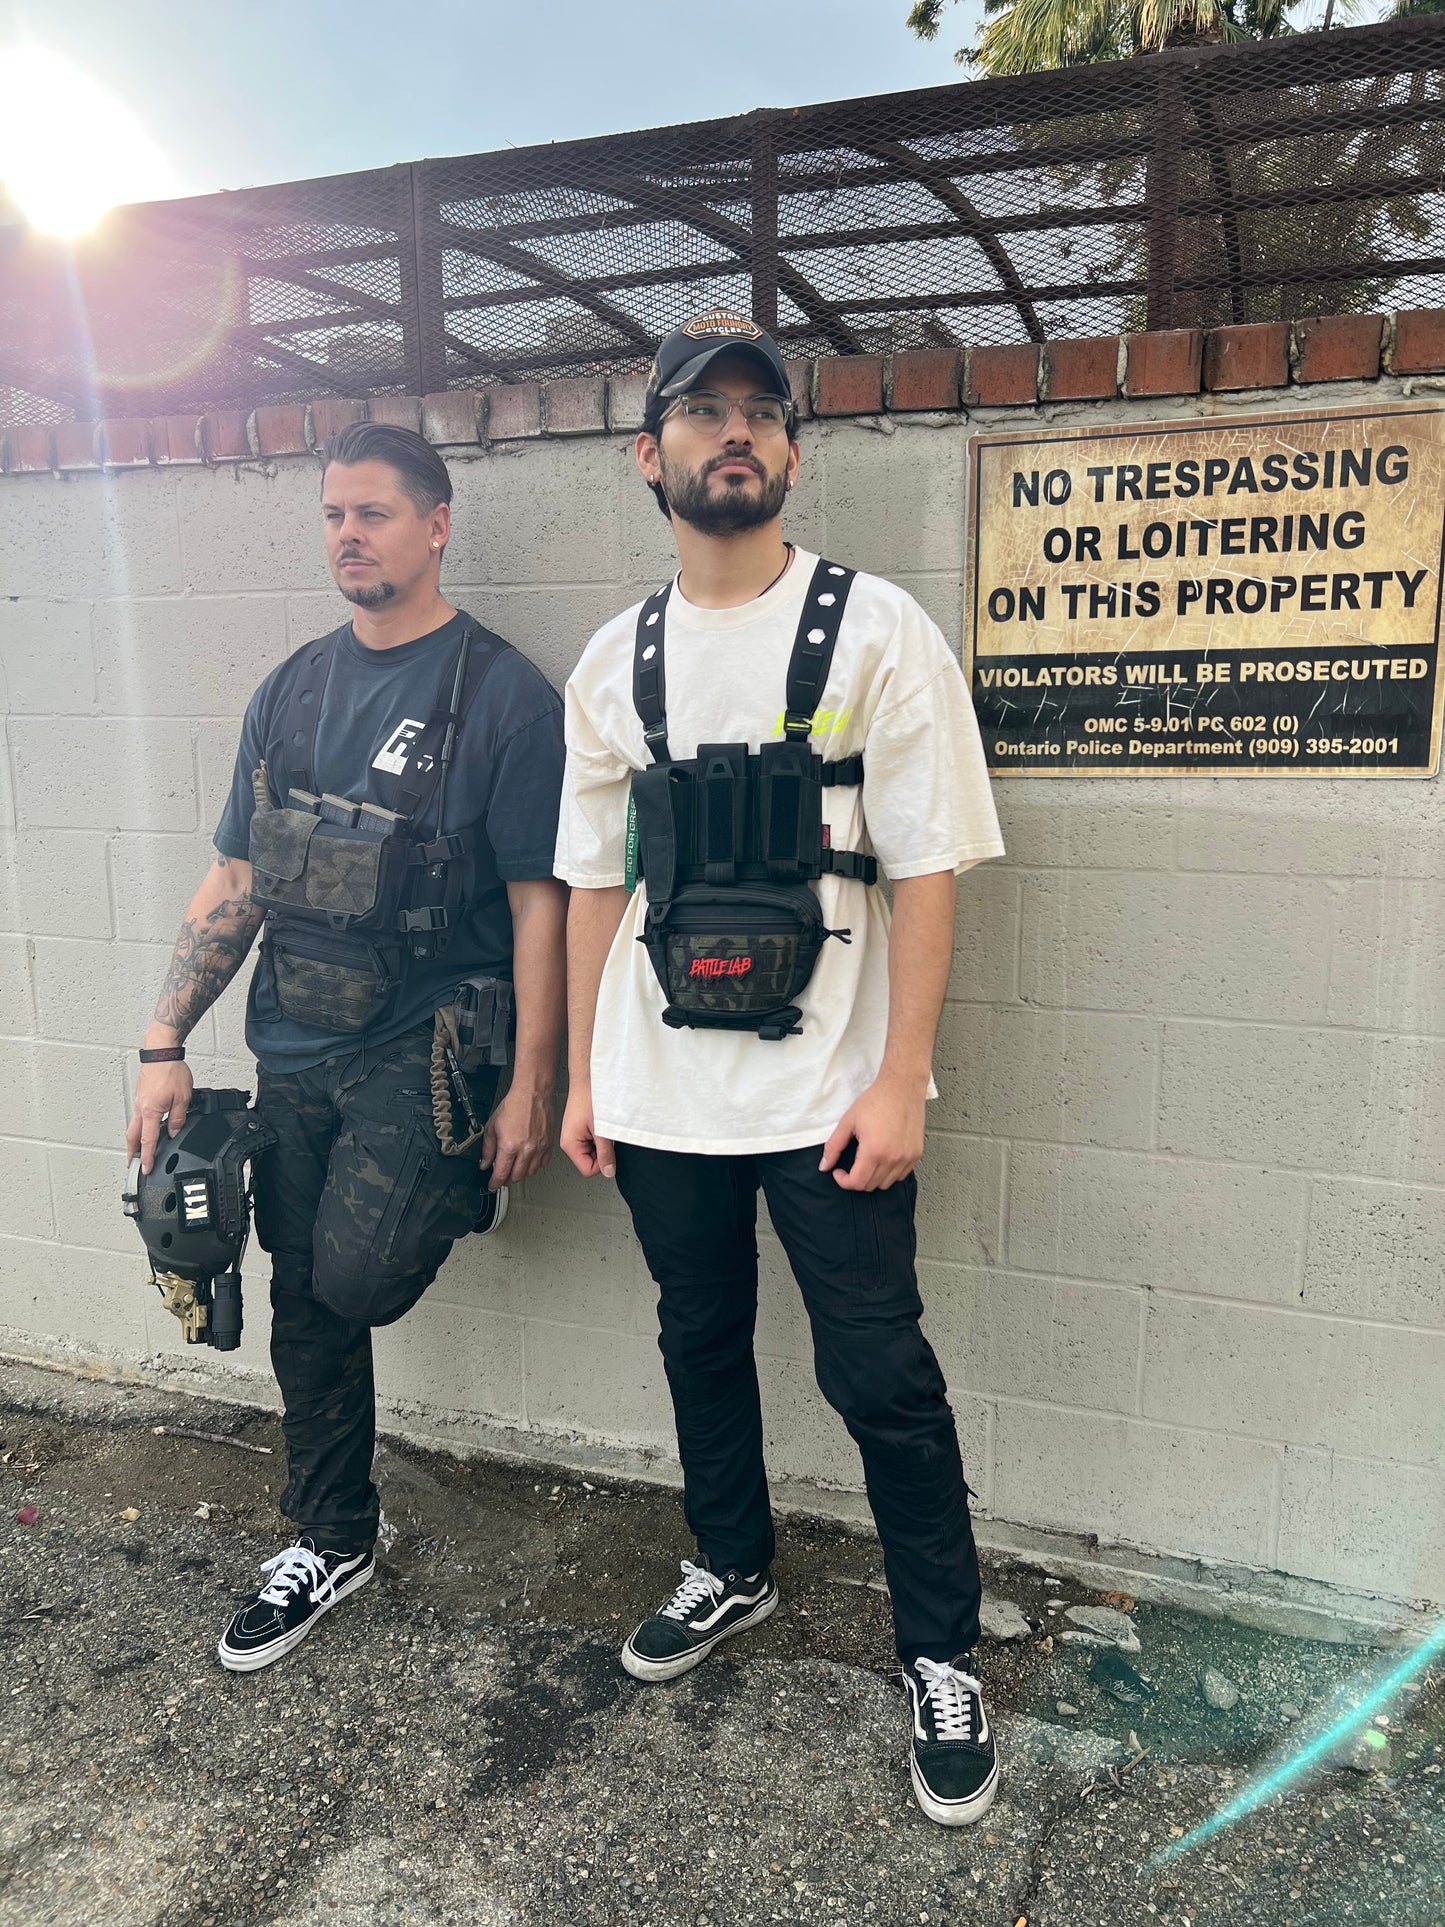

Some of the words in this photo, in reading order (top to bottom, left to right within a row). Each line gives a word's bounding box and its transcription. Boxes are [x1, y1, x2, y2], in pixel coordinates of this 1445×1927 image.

[693, 320, 716, 331] MOTO
[717, 319, 752, 331] FOUNDRY
[703, 312, 741, 321] CUSTOM
[1013, 469, 1072, 507] NO
[1087, 445, 1409, 502] TRESPASSING
[1043, 527, 1102, 563] OR
[1117, 510, 1366, 560] LOITERING
[988, 586, 1046, 623] ON
[1061, 581, 1161, 620] THIS
[1177, 569, 1429, 616] PROPERTY
[979, 665, 1118, 688] VIOLATORS
[1125, 664, 1188, 684] WILL
[1196, 663, 1232, 683] BE
[1239, 658, 1428, 683] PROSECUTED
[1084, 717, 1128, 733] OMC
[1133, 717, 1190, 733] 5-9.01
[1197, 716, 1225, 732] PC
[1230, 716, 1267, 732] 602
[994, 740, 1061, 756] Ontario
[1066, 740, 1123, 756] Police
[1128, 738, 1243, 758] Department
[1249, 738, 1300, 758] (909)
[1305, 738, 1399, 755] 395-2001
[627, 832, 635, 855] FOR
[626, 856, 633, 873] GO
[183, 1183, 208, 1220] K11
